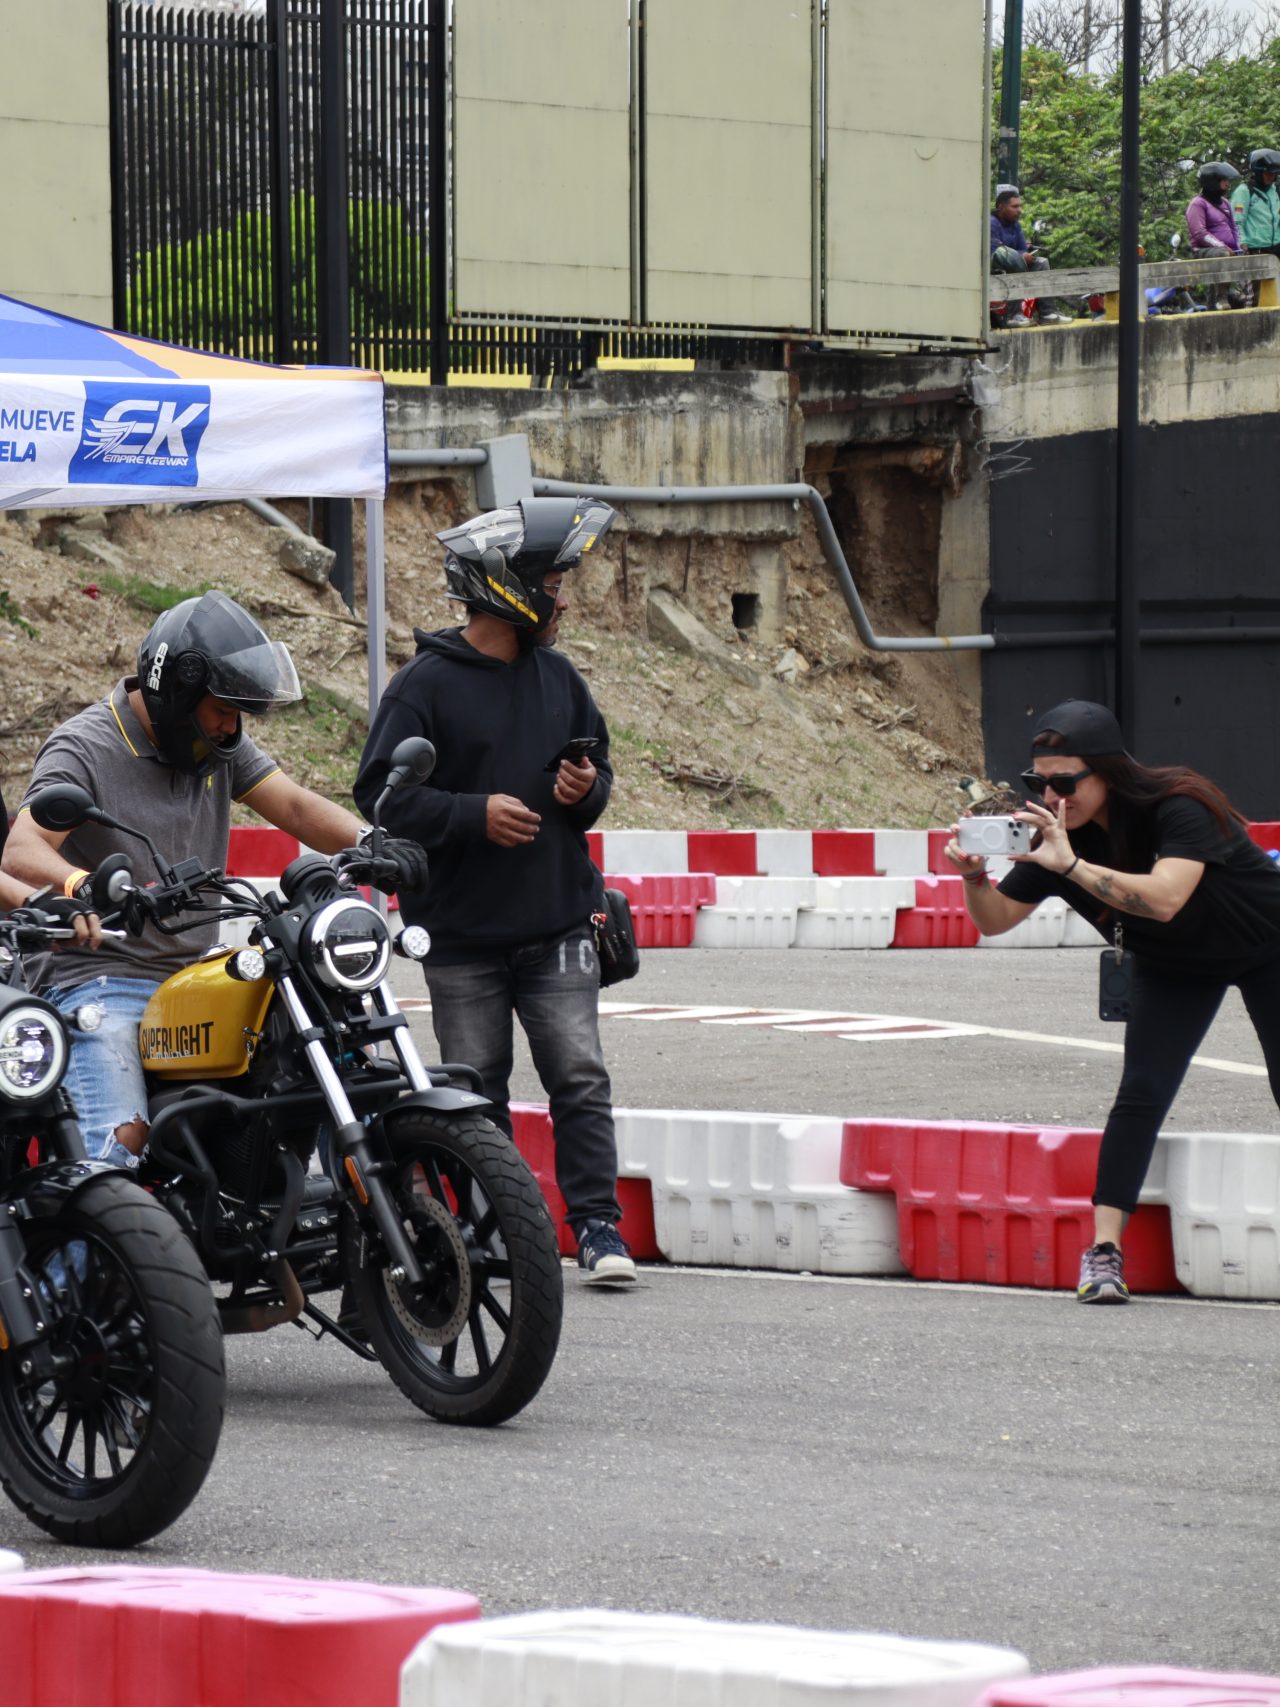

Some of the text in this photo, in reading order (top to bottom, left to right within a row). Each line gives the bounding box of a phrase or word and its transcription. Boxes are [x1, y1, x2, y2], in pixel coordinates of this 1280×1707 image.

[0, 408, 75, 432] MUEVE
[93, 399, 209, 457] EK
[102, 454, 189, 466] EMPIRE KEEWAY
[149, 642, 168, 691] EDGE
[142, 1021, 214, 1060] SUPERLIGHT
